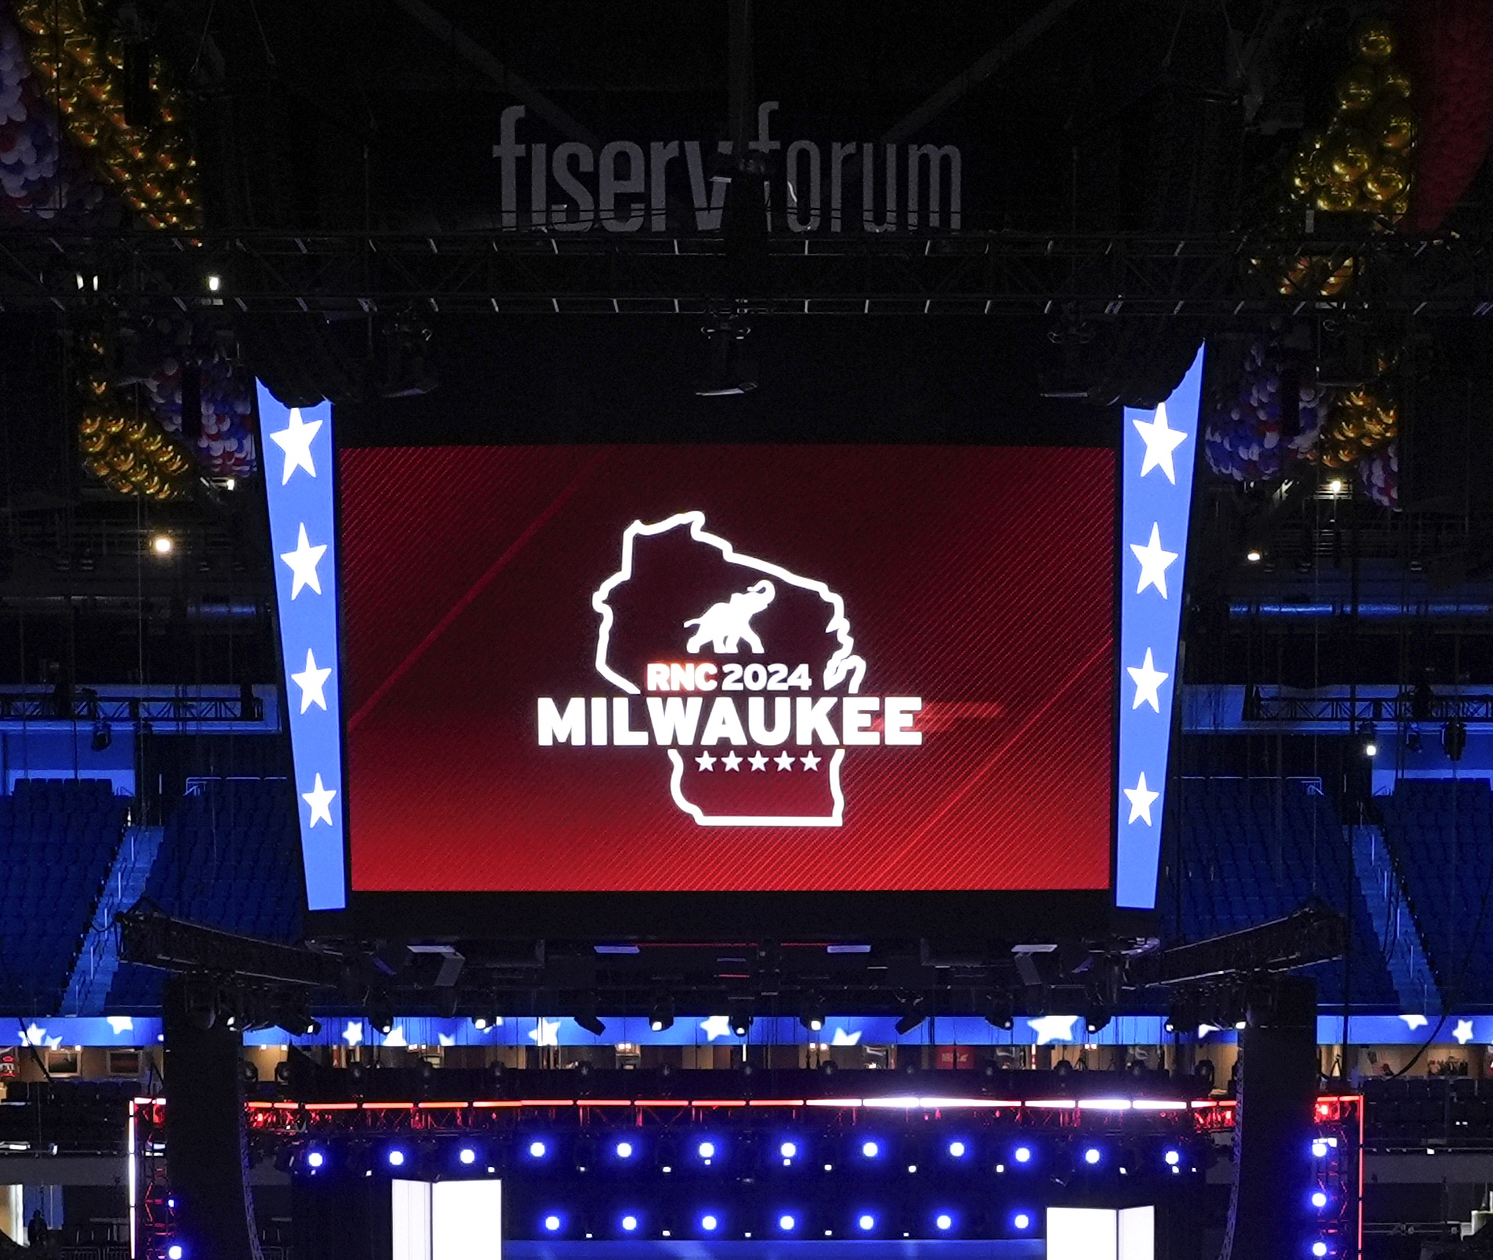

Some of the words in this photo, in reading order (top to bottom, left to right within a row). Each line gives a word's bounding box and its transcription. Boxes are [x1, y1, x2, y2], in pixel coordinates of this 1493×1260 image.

[493, 105, 734, 232] fiserv
[748, 101, 962, 232] forum
[647, 663, 718, 692] RNC
[722, 663, 812, 692] 2024
[537, 696, 923, 746] MILWAUKEE
